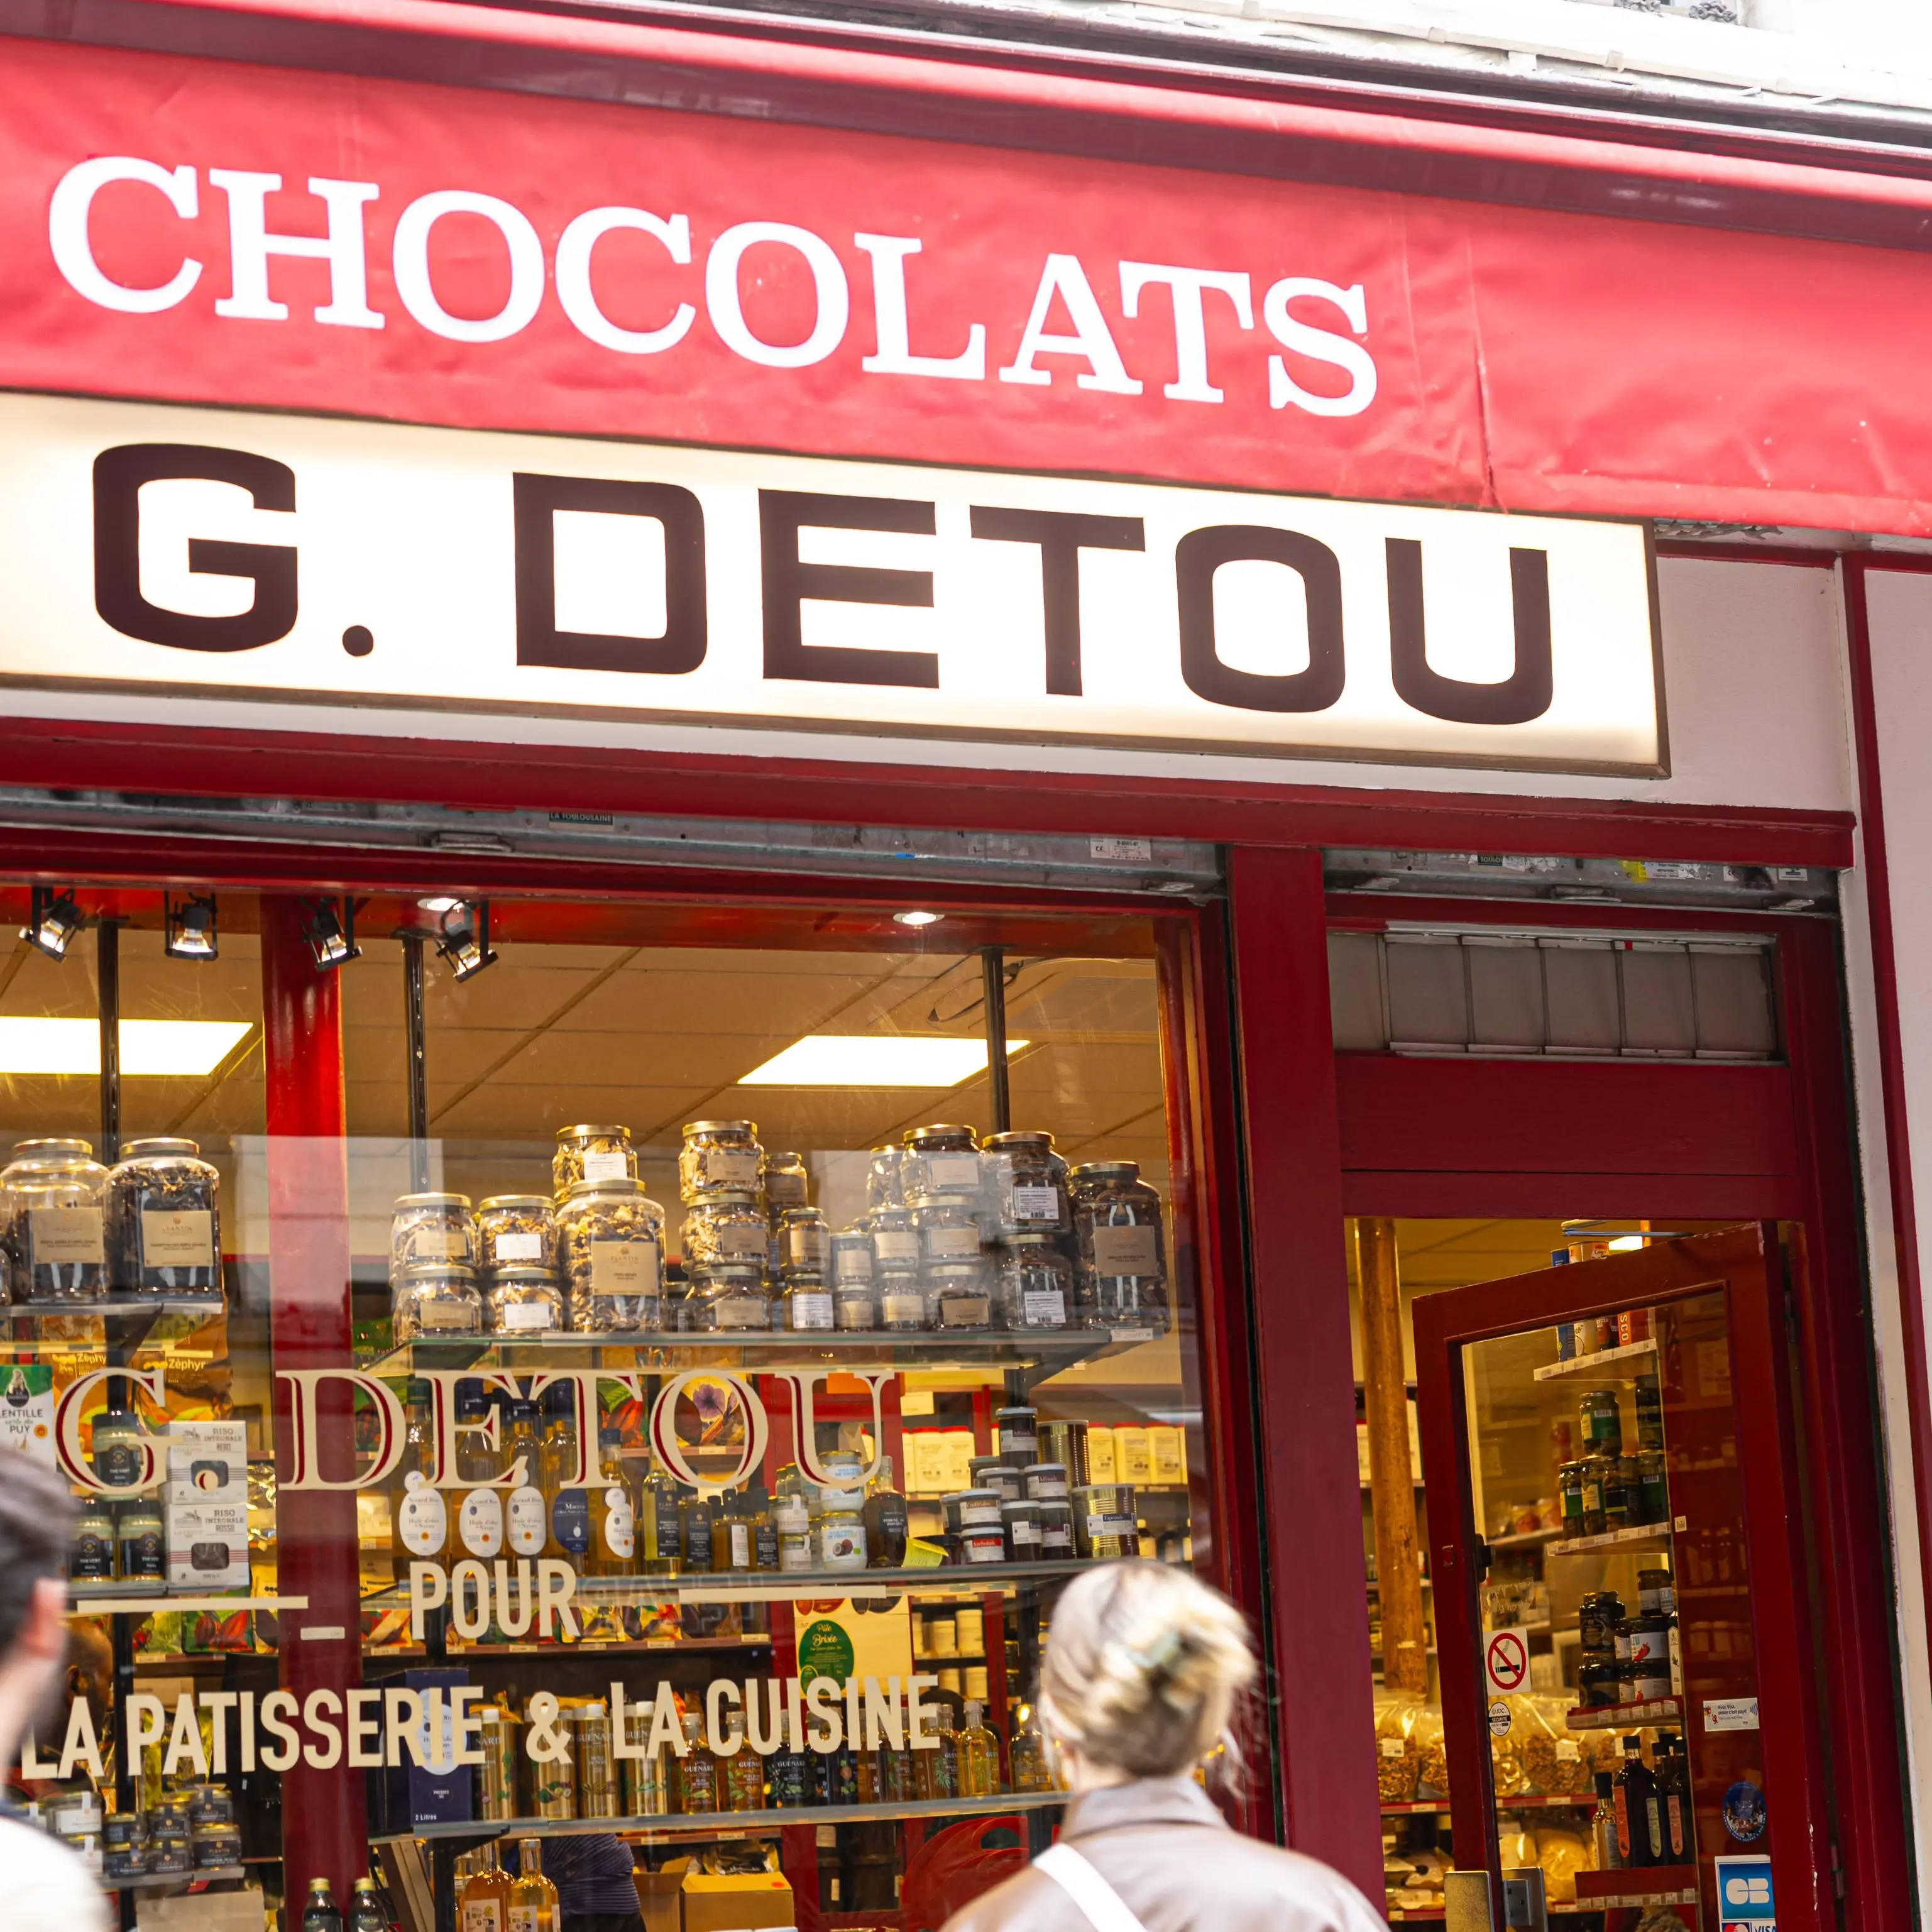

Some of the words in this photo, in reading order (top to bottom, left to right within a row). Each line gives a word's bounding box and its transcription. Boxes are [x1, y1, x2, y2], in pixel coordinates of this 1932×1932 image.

[50, 156, 1378, 417] CHOCOLATS
[94, 444, 373, 657] G.
[513, 473, 1554, 726] DETOU
[77, 1352, 107, 1364] Zéphy
[168, 1358, 207, 1371] Zéphyr
[0, 1409, 43, 1419] ENTILLE
[10, 1425, 30, 1434] PUY
[213, 1427, 234, 1435] RISO
[275, 1368, 896, 1491] DETOU
[214, 1509, 236, 1517] RISO
[409, 1559, 580, 1640] POUR
[813, 1633, 838, 1647] Brisée
[22, 1696, 105, 1780] LA
[126, 1686, 486, 1777] PATISSERIE
[526, 1691, 573, 1765] &
[610, 1680, 688, 1760] LA
[706, 1674, 941, 1757] CUISINE
[576, 1733, 613, 1742] GUENAR
[625, 1730, 649, 1739] GUEN
[738, 1760, 760, 1768] GUENA
[420, 1813, 437, 1821] Litres
